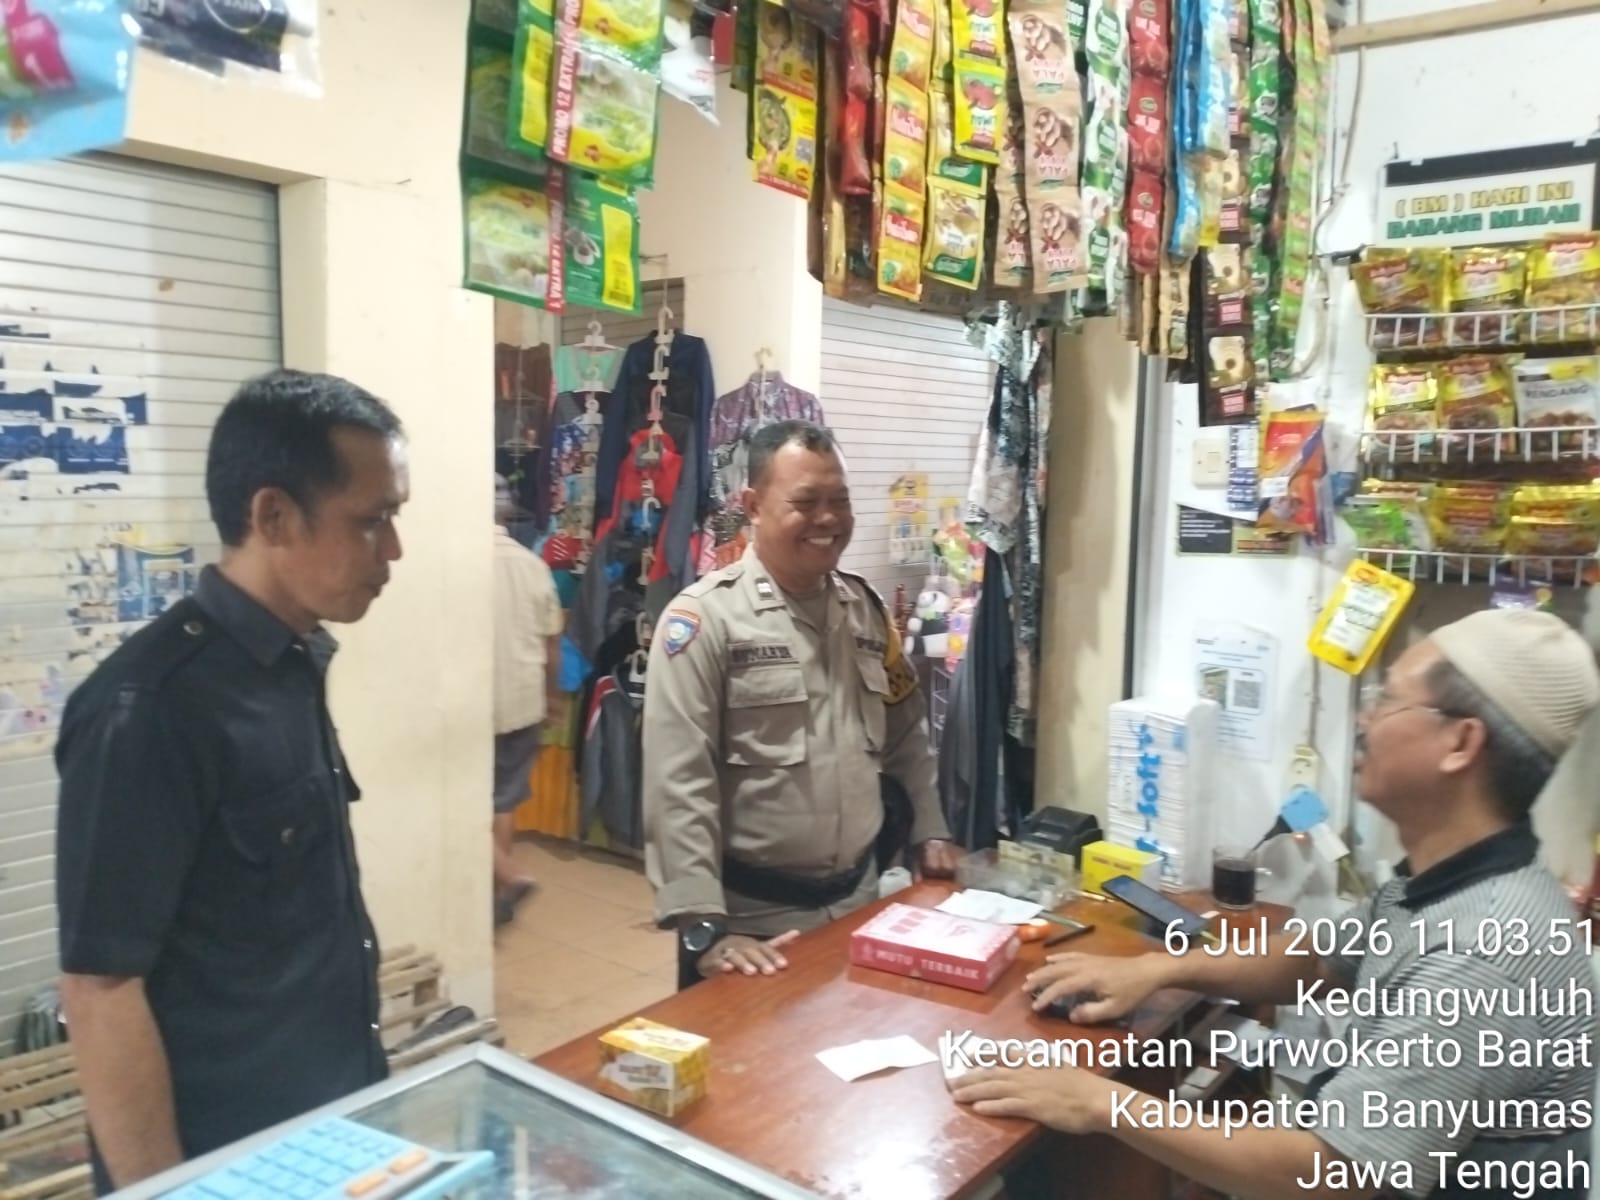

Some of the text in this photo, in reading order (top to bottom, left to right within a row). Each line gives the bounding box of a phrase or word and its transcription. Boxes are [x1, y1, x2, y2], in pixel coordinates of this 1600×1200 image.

[557, 47, 575, 91] EXTRA
[556, 92, 570, 107] 12
[553, 110, 570, 155] PROMO
[1411, 194, 1449, 216] BM
[1470, 186, 1531, 209] HARI
[1537, 181, 1575, 202] INI
[1386, 203, 1581, 240] BARANG MURAH
[876, 948, 980, 980] MUTU TERBAIK
